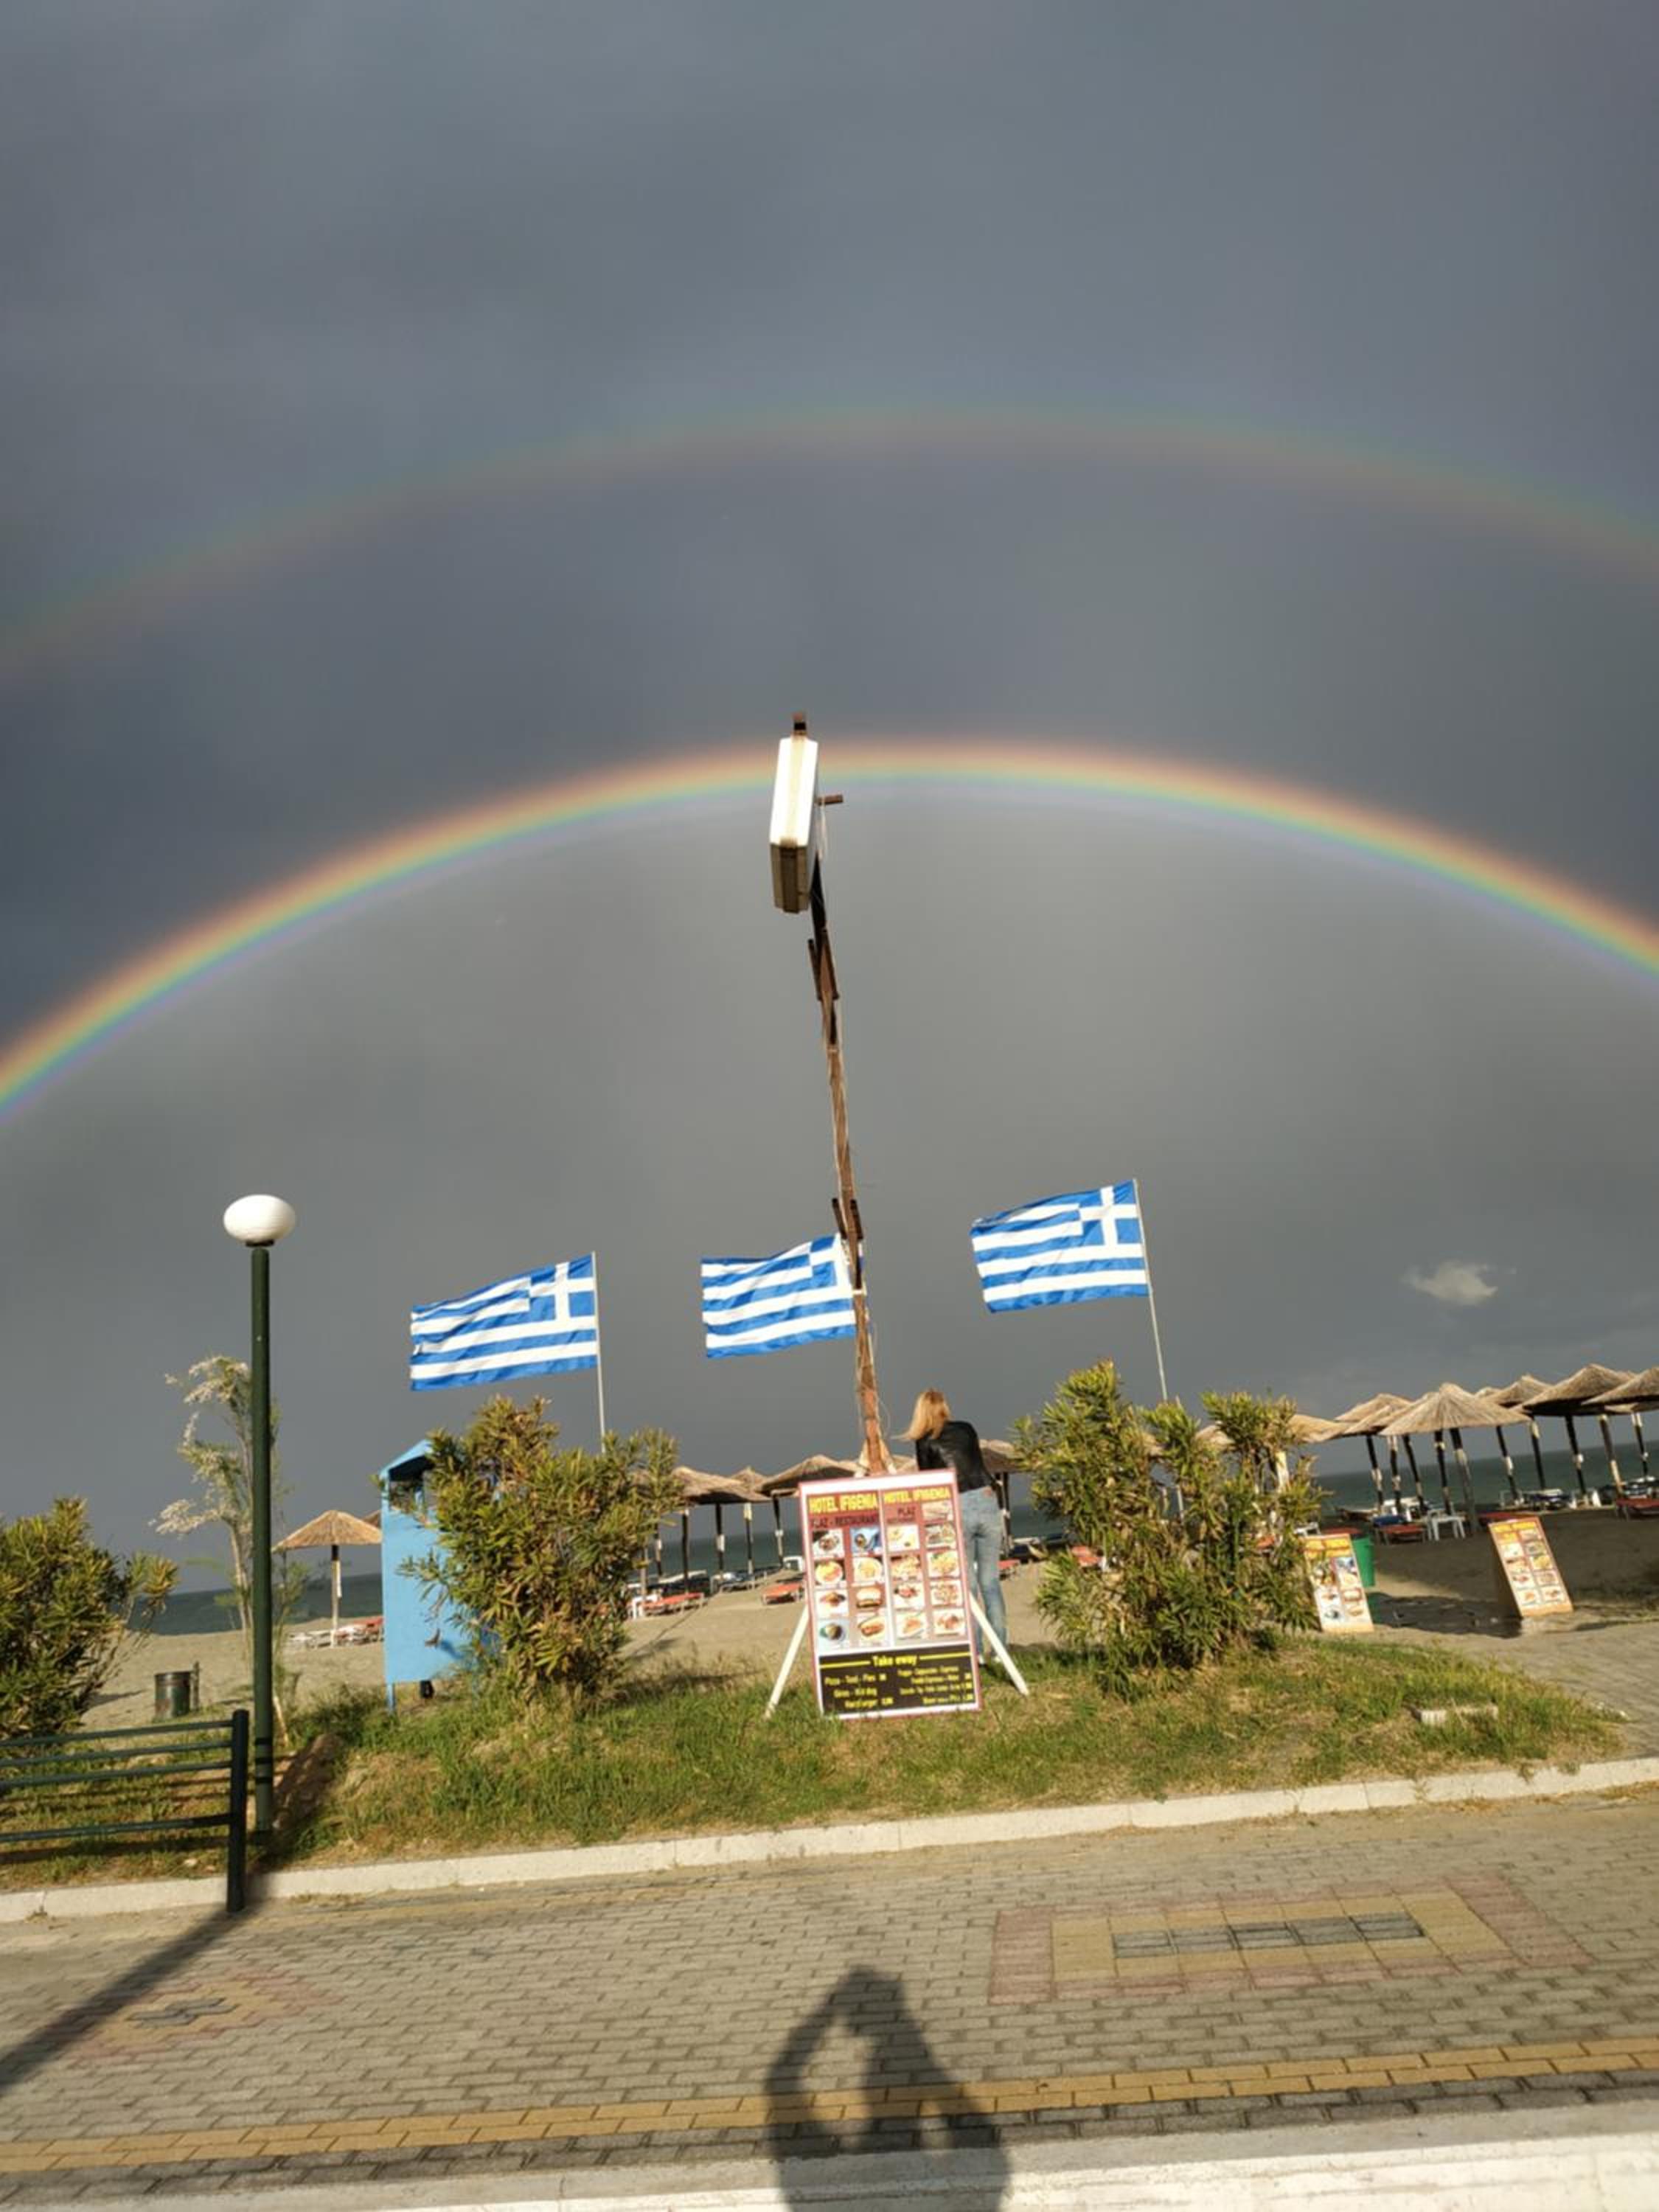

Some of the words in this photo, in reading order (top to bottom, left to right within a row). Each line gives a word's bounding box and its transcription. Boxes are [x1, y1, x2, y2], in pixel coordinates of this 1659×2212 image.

[809, 1496, 838, 1512] HOTEL
[872, 1655, 894, 1667] Take
[894, 1655, 917, 1666] away
